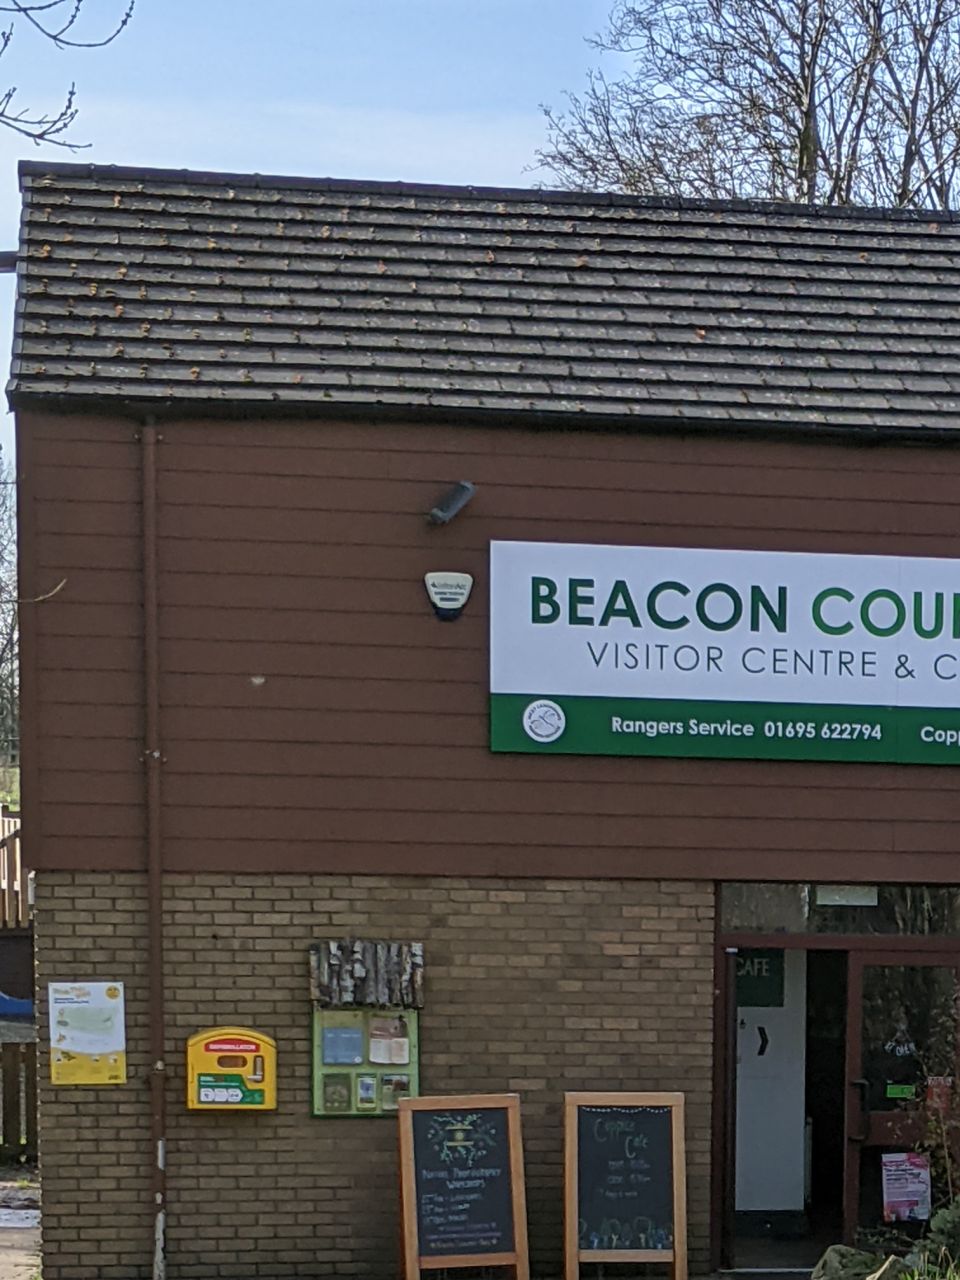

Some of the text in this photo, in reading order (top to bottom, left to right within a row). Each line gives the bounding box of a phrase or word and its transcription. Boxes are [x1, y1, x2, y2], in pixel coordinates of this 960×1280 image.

[531, 576, 787, 633] BEACON
[587, 642, 723, 672] VISITOR
[742, 647, 876, 677] CENTRE
[895, 654, 915, 679] &
[612, 717, 881, 740] Rangers Service 01695 622794
[736, 957, 770, 977] CAFE
